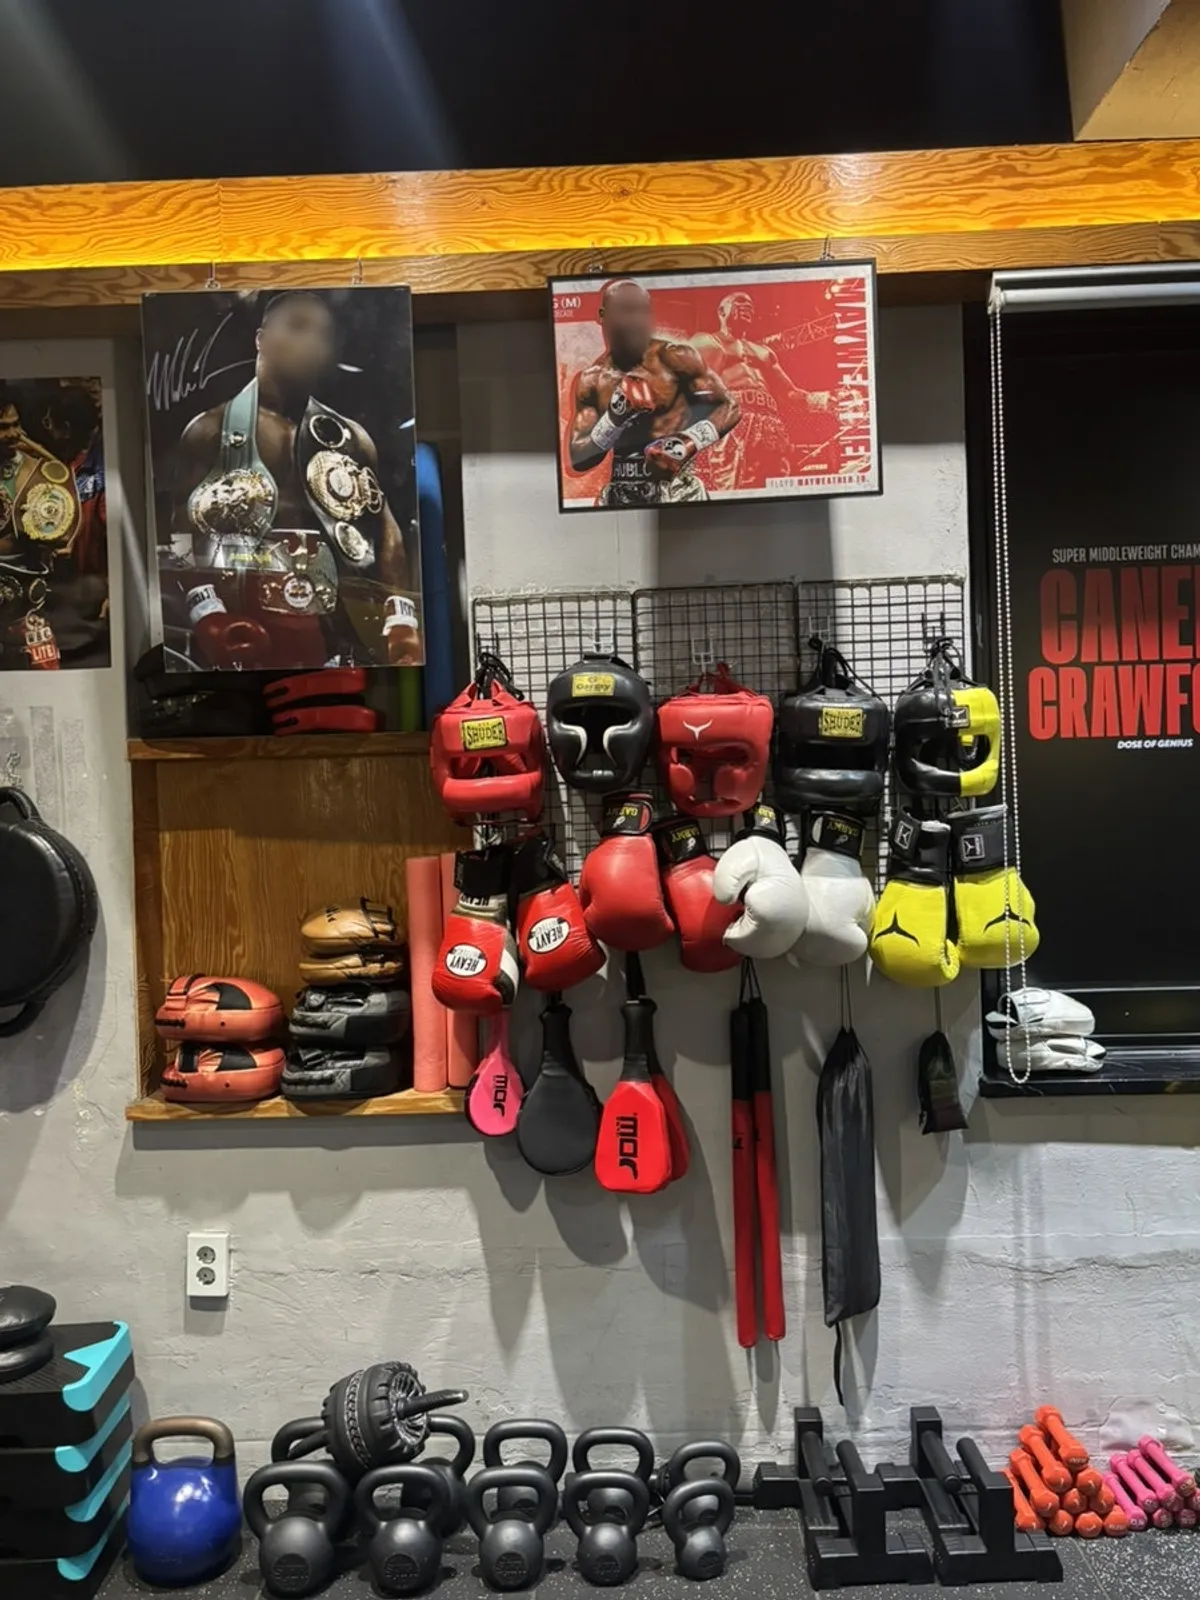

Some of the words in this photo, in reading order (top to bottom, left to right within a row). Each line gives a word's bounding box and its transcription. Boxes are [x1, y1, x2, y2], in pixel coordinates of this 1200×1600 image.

[1052, 547, 1086, 564] SUPER
[1089, 544, 1167, 562] MIDDLEWEIGHT
[1040, 565, 1200, 665] CANE
[1028, 663, 1200, 740] CRAWF
[1117, 740, 1142, 749] DOSE
[1143, 740, 1157, 749] OF
[1158, 739, 1194, 748] GENIUS
[536, 926, 564, 950] HEAVY
[449, 954, 480, 972] HEAVY
